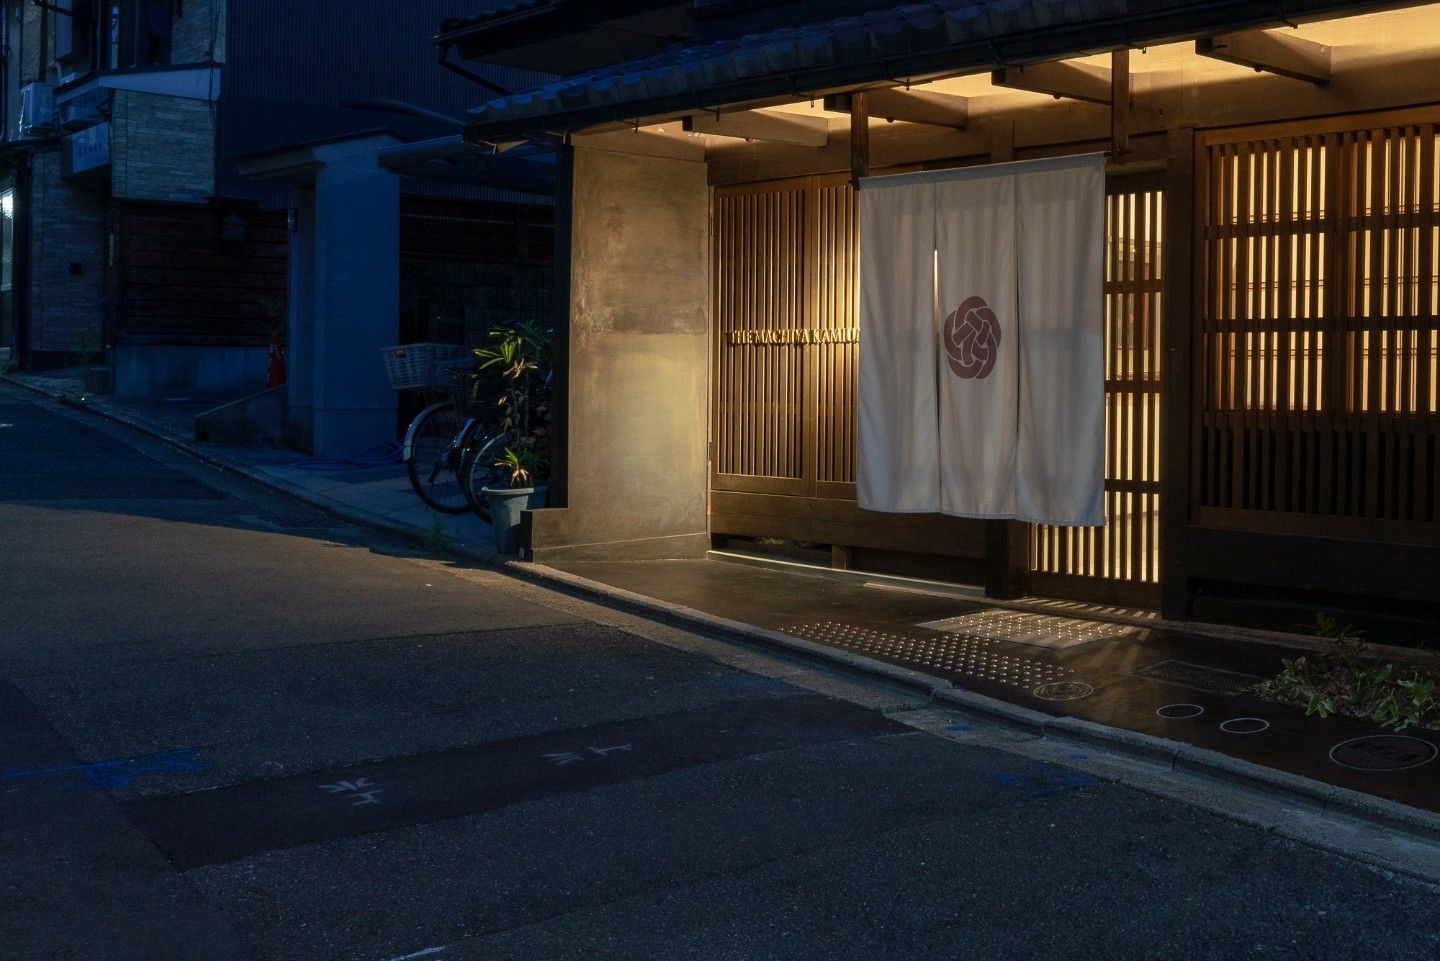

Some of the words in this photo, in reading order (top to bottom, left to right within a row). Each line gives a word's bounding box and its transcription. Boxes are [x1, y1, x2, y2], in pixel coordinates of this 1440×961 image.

[730, 329, 752, 344] THE
[755, 329, 809, 344] MACHIYA
[813, 327, 859, 343] KAMIU
